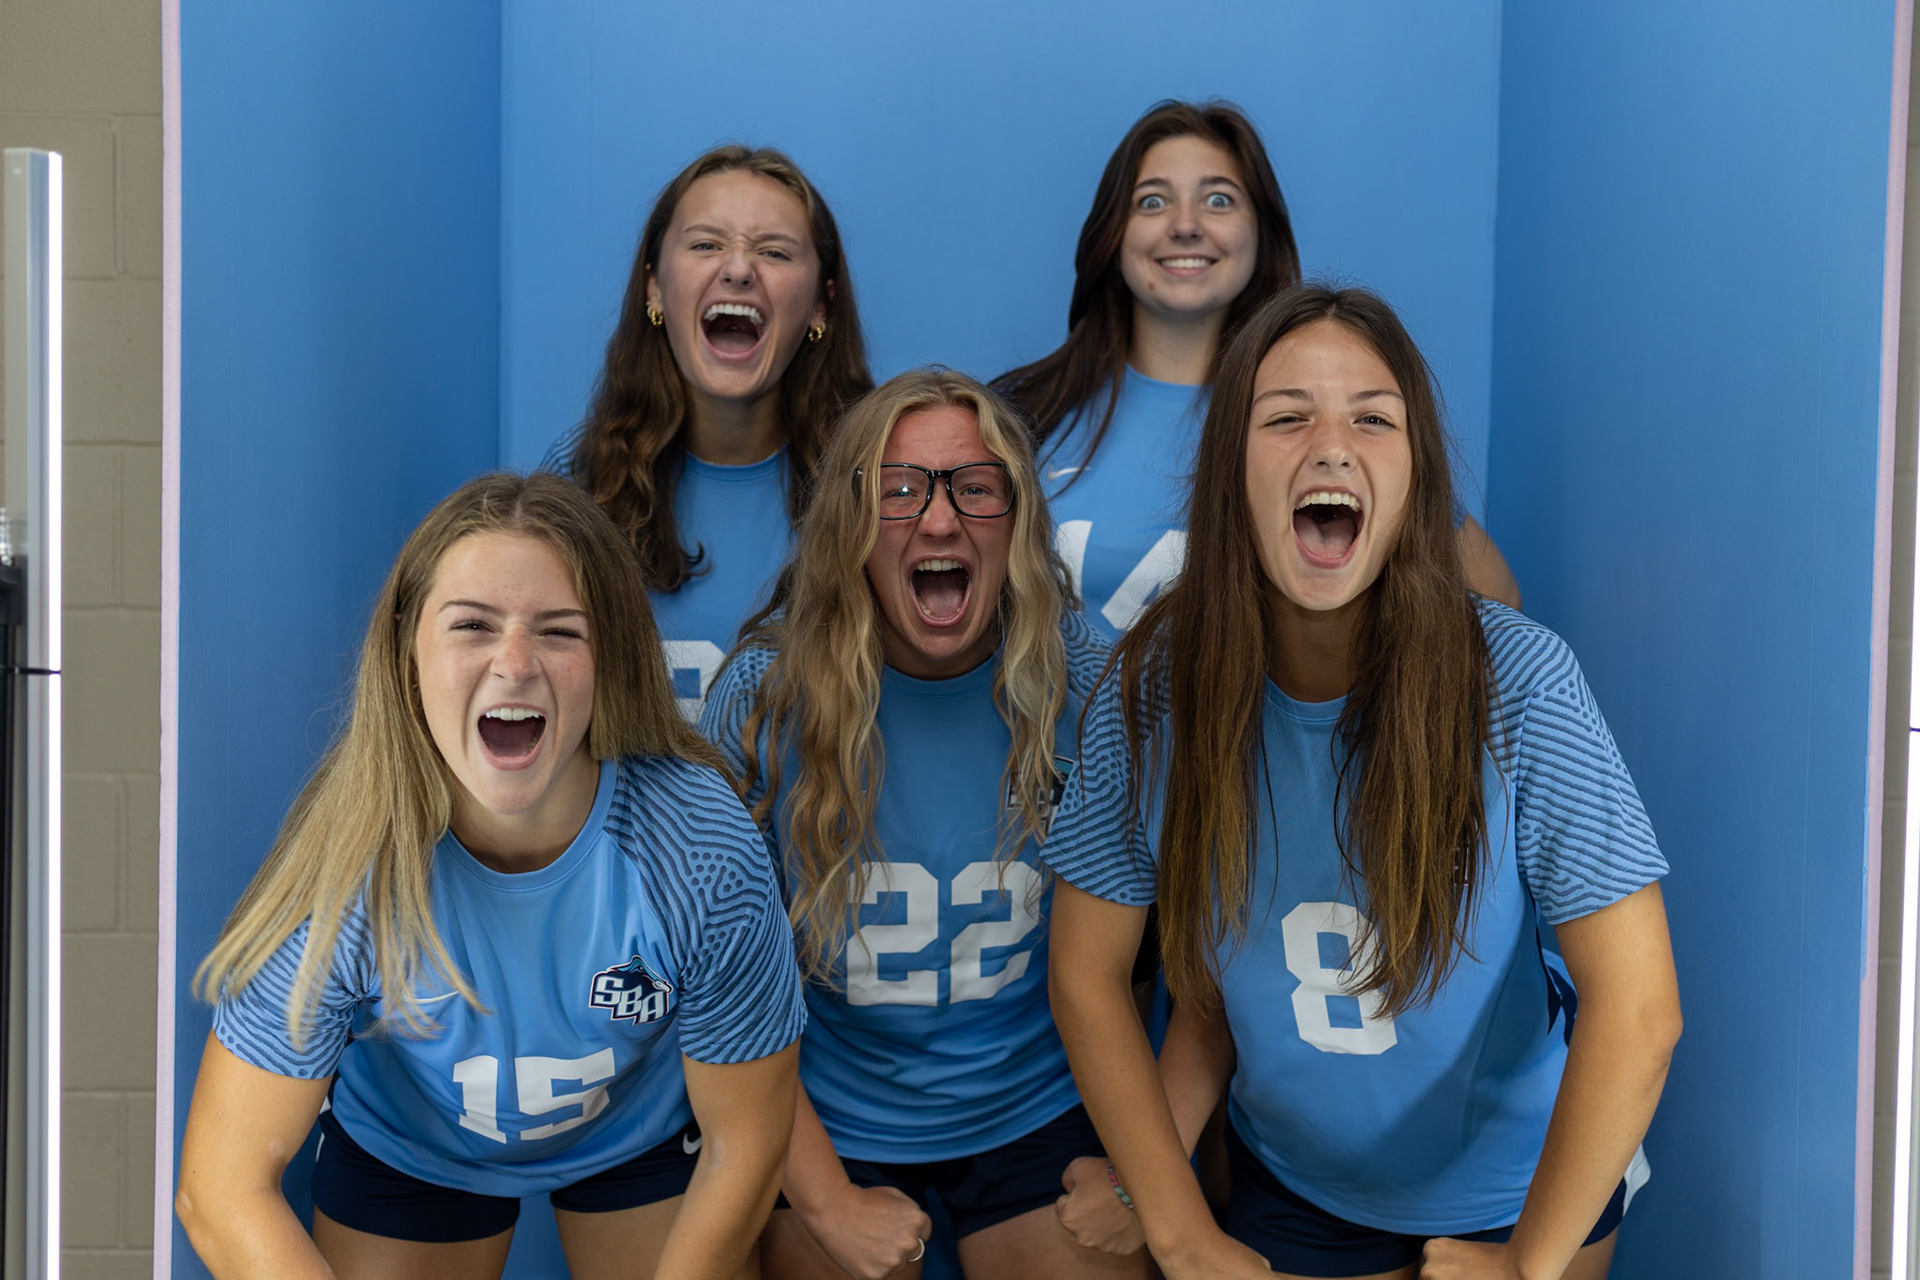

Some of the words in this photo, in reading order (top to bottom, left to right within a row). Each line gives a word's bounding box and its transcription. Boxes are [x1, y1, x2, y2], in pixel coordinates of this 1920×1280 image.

[847, 861, 1042, 1007] 22
[1281, 902, 1398, 1055] 8
[594, 975, 664, 1023] SBA
[453, 1048, 615, 1144] 15
